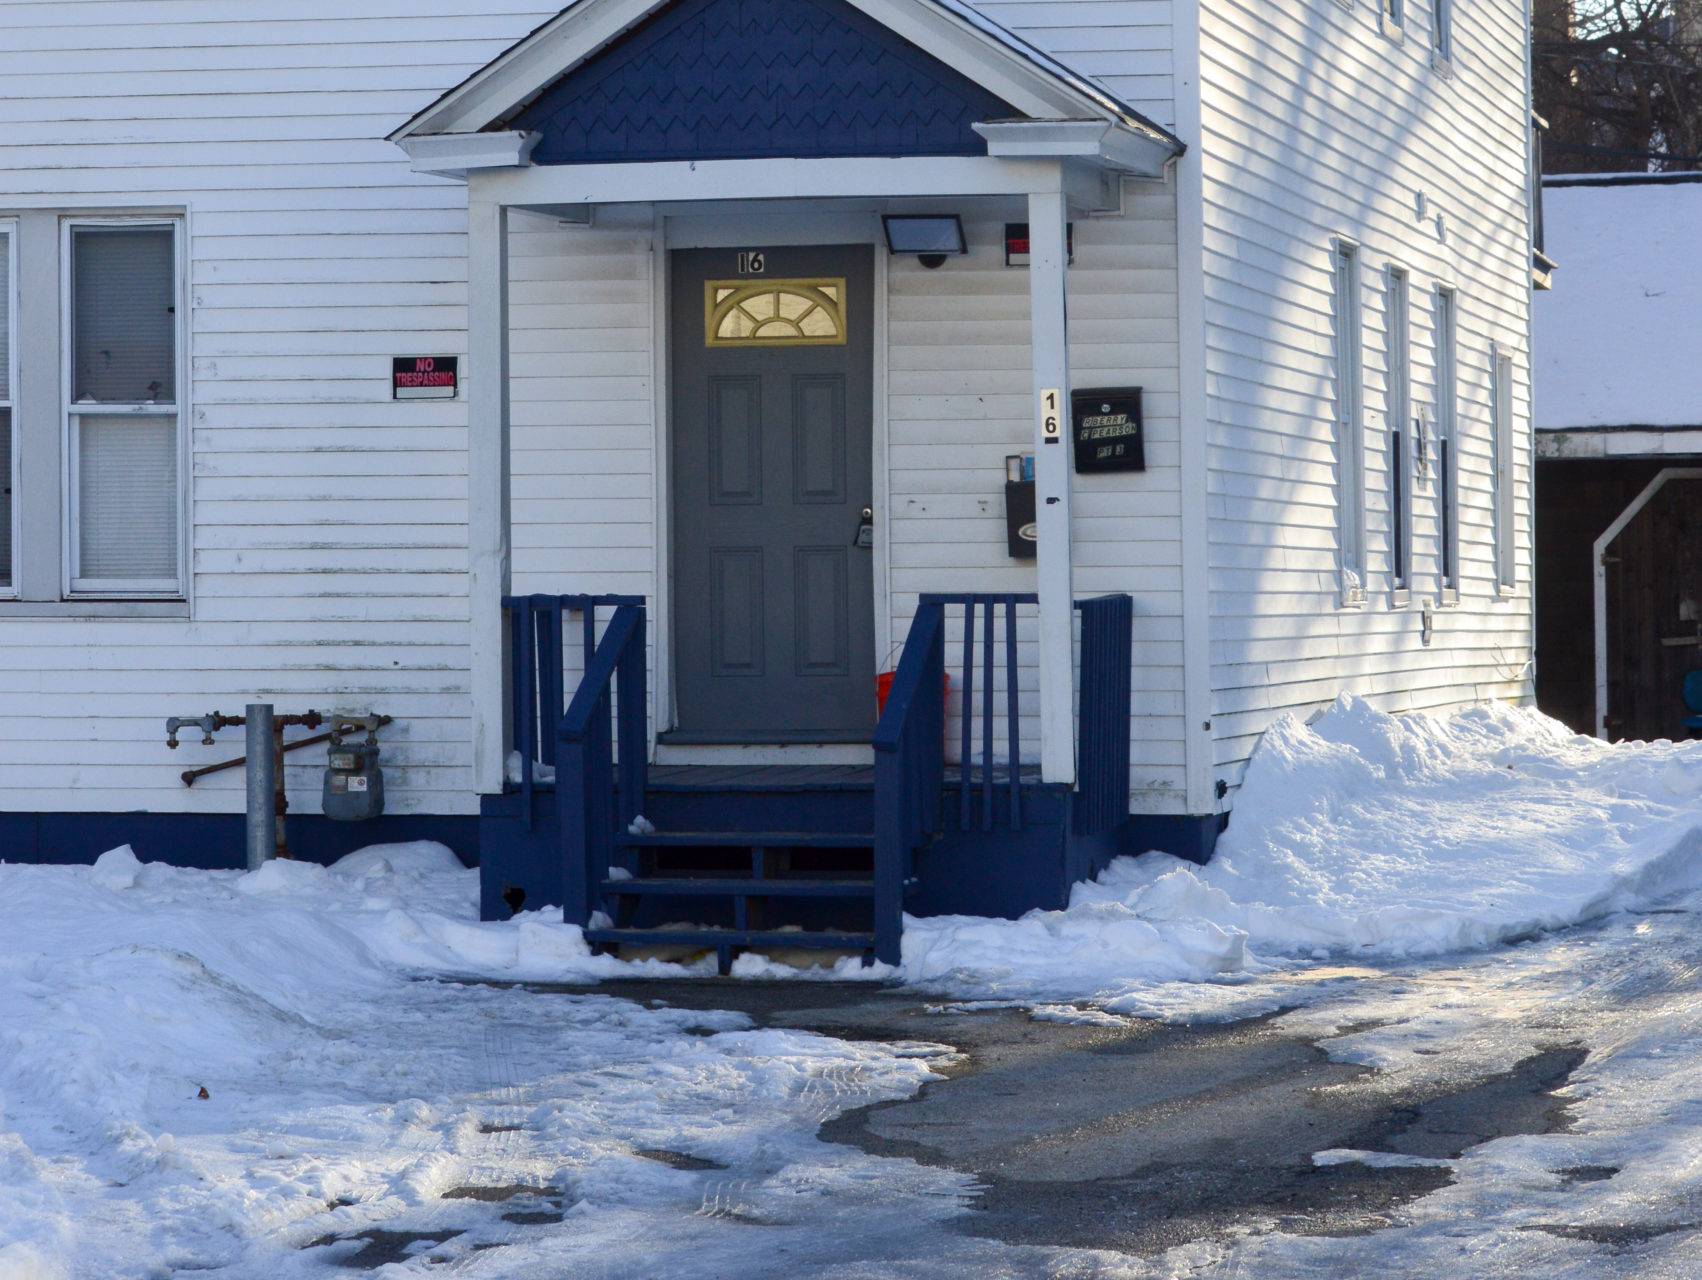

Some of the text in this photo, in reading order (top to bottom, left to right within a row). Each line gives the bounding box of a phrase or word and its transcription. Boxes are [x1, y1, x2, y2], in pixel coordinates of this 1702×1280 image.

[739, 252, 763, 272] 16
[416, 358, 434, 372] NO
[396, 372, 454, 386] TRESPASSING
[1091, 424, 1136, 438] PEARSON
